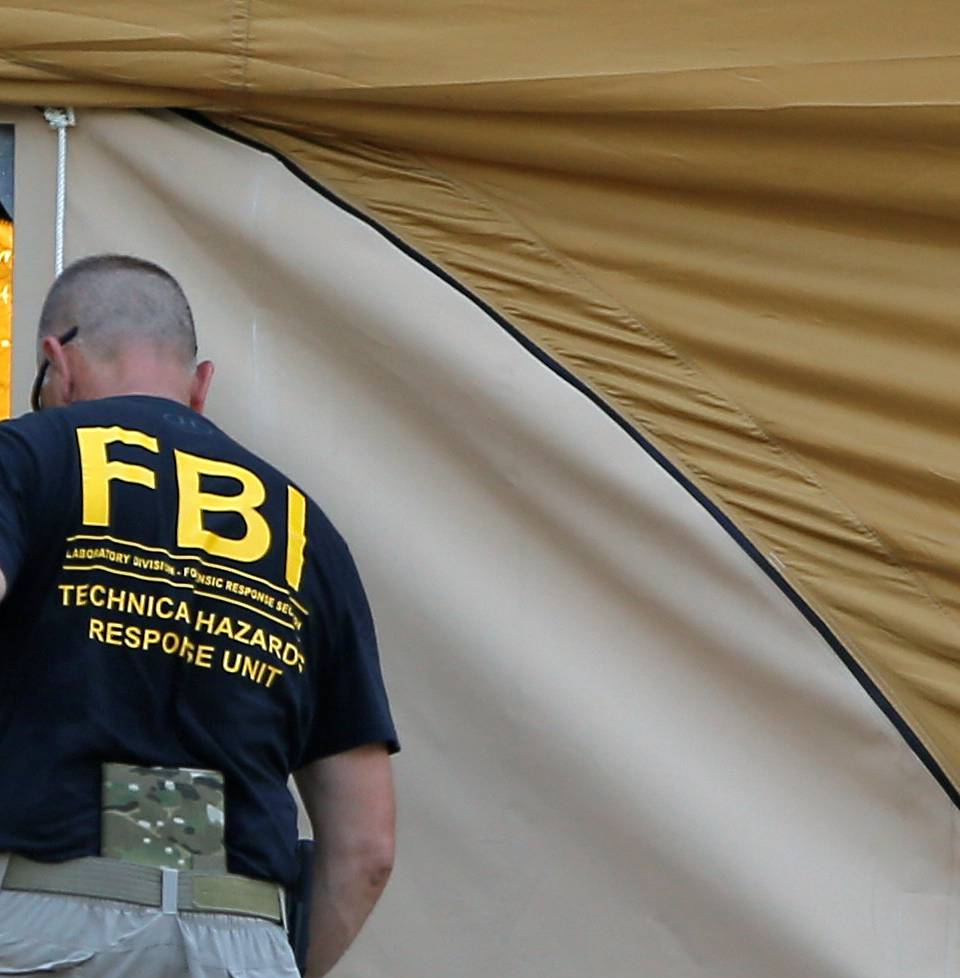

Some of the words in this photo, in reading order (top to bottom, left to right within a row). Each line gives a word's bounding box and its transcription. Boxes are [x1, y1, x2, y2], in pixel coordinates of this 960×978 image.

[76, 426, 306, 591] FBI
[66, 548, 131, 564] LABORATORY
[184, 567, 224, 588] FONSIC
[225, 580, 275, 608] RESPONSE
[58, 584, 190, 624] TECHNICA
[223, 651, 283, 688] UNIT
